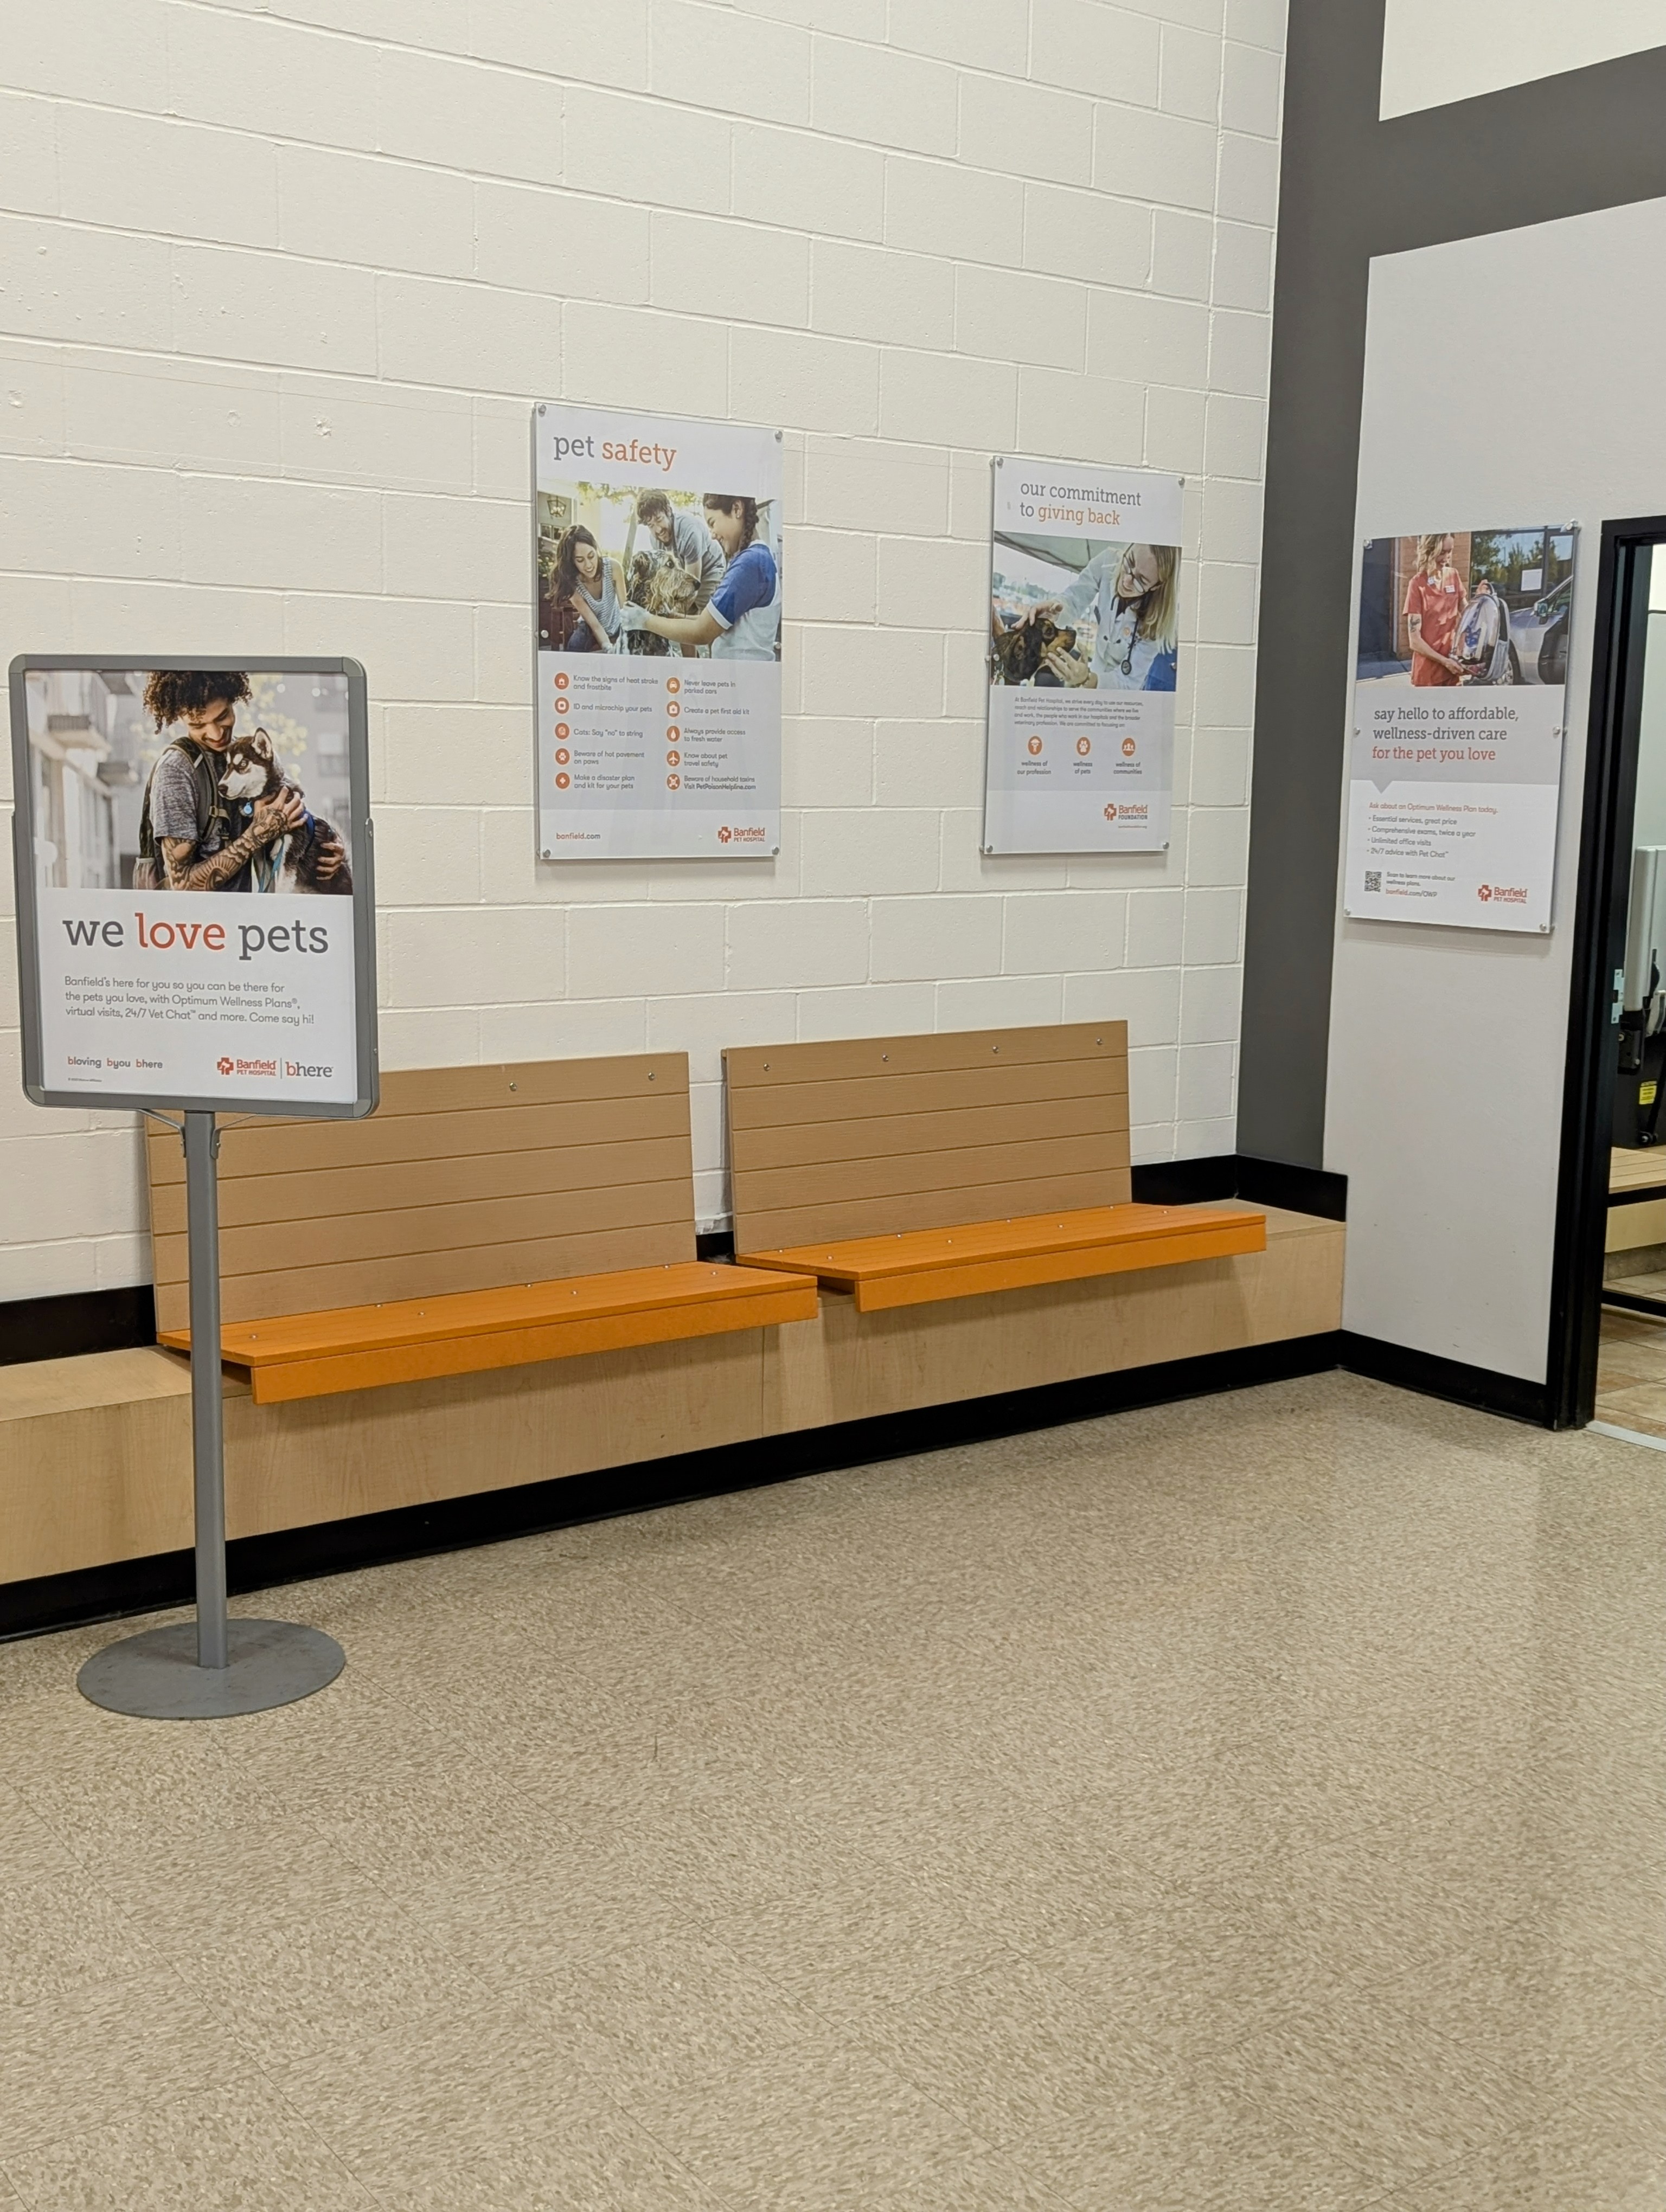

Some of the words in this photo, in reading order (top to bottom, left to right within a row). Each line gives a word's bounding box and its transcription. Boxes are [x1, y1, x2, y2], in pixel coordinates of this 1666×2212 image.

[553, 436, 594, 460] pet
[602, 439, 676, 472] safety
[1021, 483, 1045, 497] our
[1049, 486, 1141, 506] commitment
[1020, 502, 1034, 517] to
[1038, 504, 1084, 525] giving
[1088, 507, 1119, 525] back
[1374, 709, 1395, 722] say
[1398, 707, 1428, 719] hello
[1432, 708, 1445, 719] to
[1448, 707, 1518, 722] affordable,
[1373, 727, 1475, 740] wellness-driven
[1478, 729, 1507, 740] care
[1372, 747, 1391, 759] for
[1393, 747, 1413, 759] the
[1417, 748, 1437, 762] pet
[1440, 749, 1464, 762] you
[1468, 747, 1496, 760] love
[1119, 805, 1148, 813] Banfield
[734, 827, 765, 836] Banfield
[1495, 887, 1528, 897] Banfield
[63, 919, 124, 947] we
[135, 913, 225, 950] love
[238, 919, 329, 960] pets
[65, 976, 110, 987] Banfield's
[113, 978, 133, 987] here
[136, 978, 150, 988] for
[152, 982, 170, 991] you
[187, 983, 204, 992] you
[229, 981, 240, 991] be
[244, 982, 268, 992] there
[271, 982, 285, 992] for
[66, 992, 80, 1001] the
[83, 993, 103, 1003] pets
[106, 994, 124, 1005] you
[126, 993, 147, 1004] love,
[150, 994, 169, 1003] with
[172, 994, 217, 1006] Optimum
[220, 996, 262, 1006] Wellness
[66, 1006, 94, 1015] virtual
[98, 1007, 123, 1018] visits,
[125, 1008, 146, 1018] 24/7
[149, 1009, 163, 1018] Vet
[198, 1012, 217, 1020] and
[249, 1012, 279, 1023] Come
[281, 1015, 299, 1026] say
[303, 1014, 314, 1024] hi!
[68, 1057, 101, 1068] bloving
[107, 1058, 131, 1069] byou
[136, 1059, 163, 1068] bhere
[237, 1059, 277, 1070] Banfield
